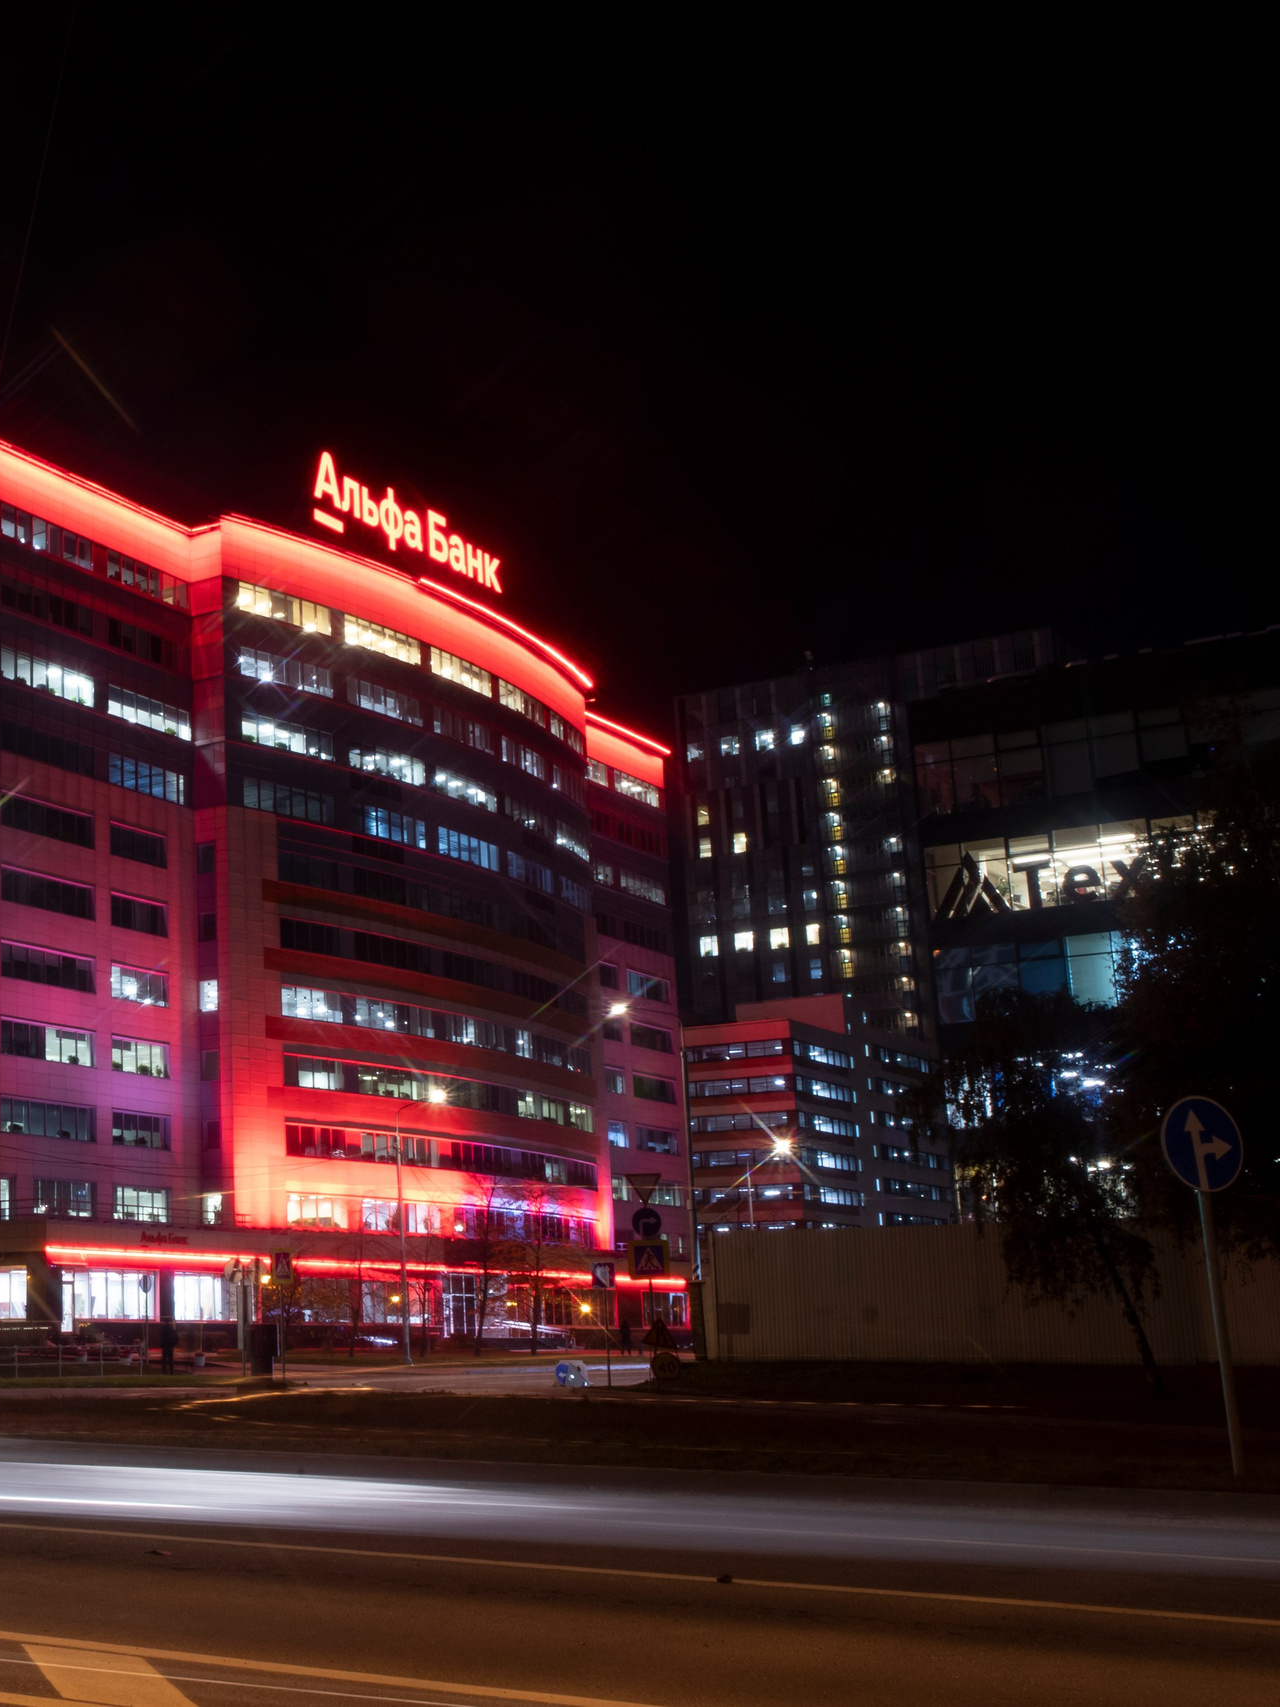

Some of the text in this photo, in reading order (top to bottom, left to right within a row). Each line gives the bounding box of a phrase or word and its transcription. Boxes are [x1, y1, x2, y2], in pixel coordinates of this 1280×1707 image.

[314, 451, 502, 594] Альфа Банк
[659, 1361, 675, 1373] 40
